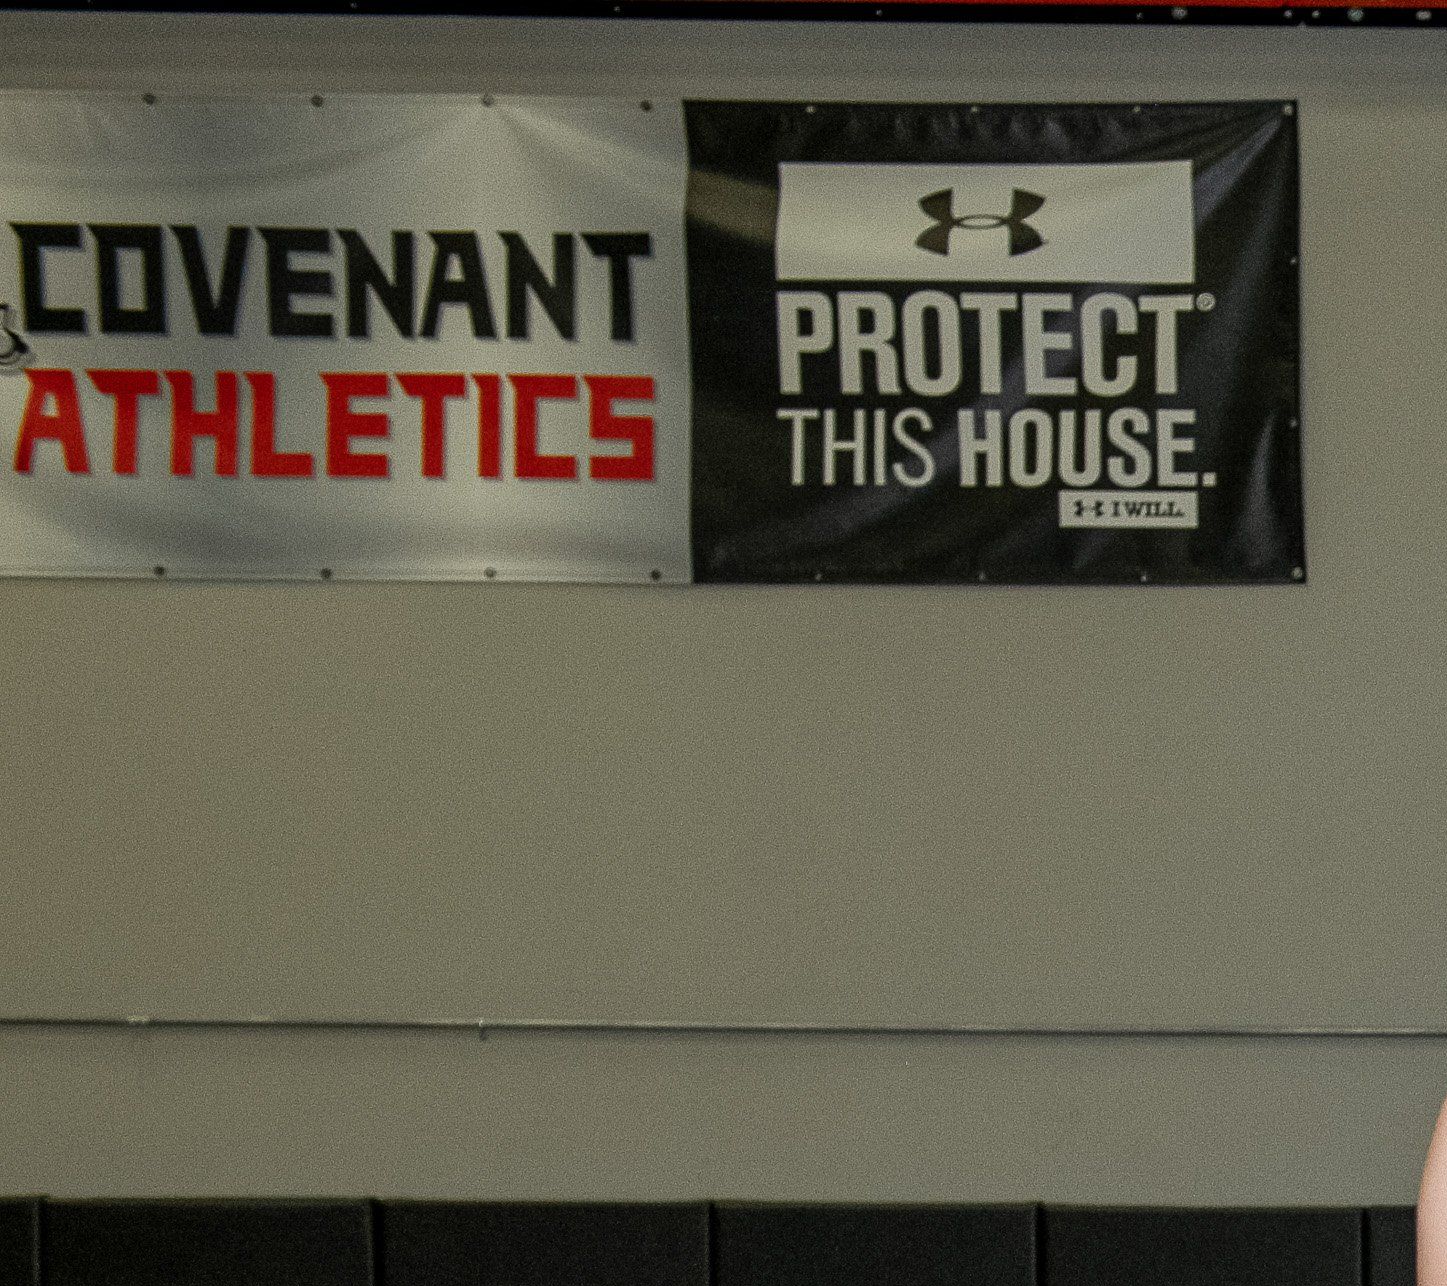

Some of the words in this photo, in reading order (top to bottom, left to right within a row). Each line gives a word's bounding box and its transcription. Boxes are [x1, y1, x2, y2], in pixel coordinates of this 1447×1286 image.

[9, 222, 652, 342] COVENANT
[12, 368, 656, 481] ATHLETICS
[776, 407, 936, 488] THIS
[957, 406, 1217, 488] HOUSE.
[1112, 501, 1121, 517] I
